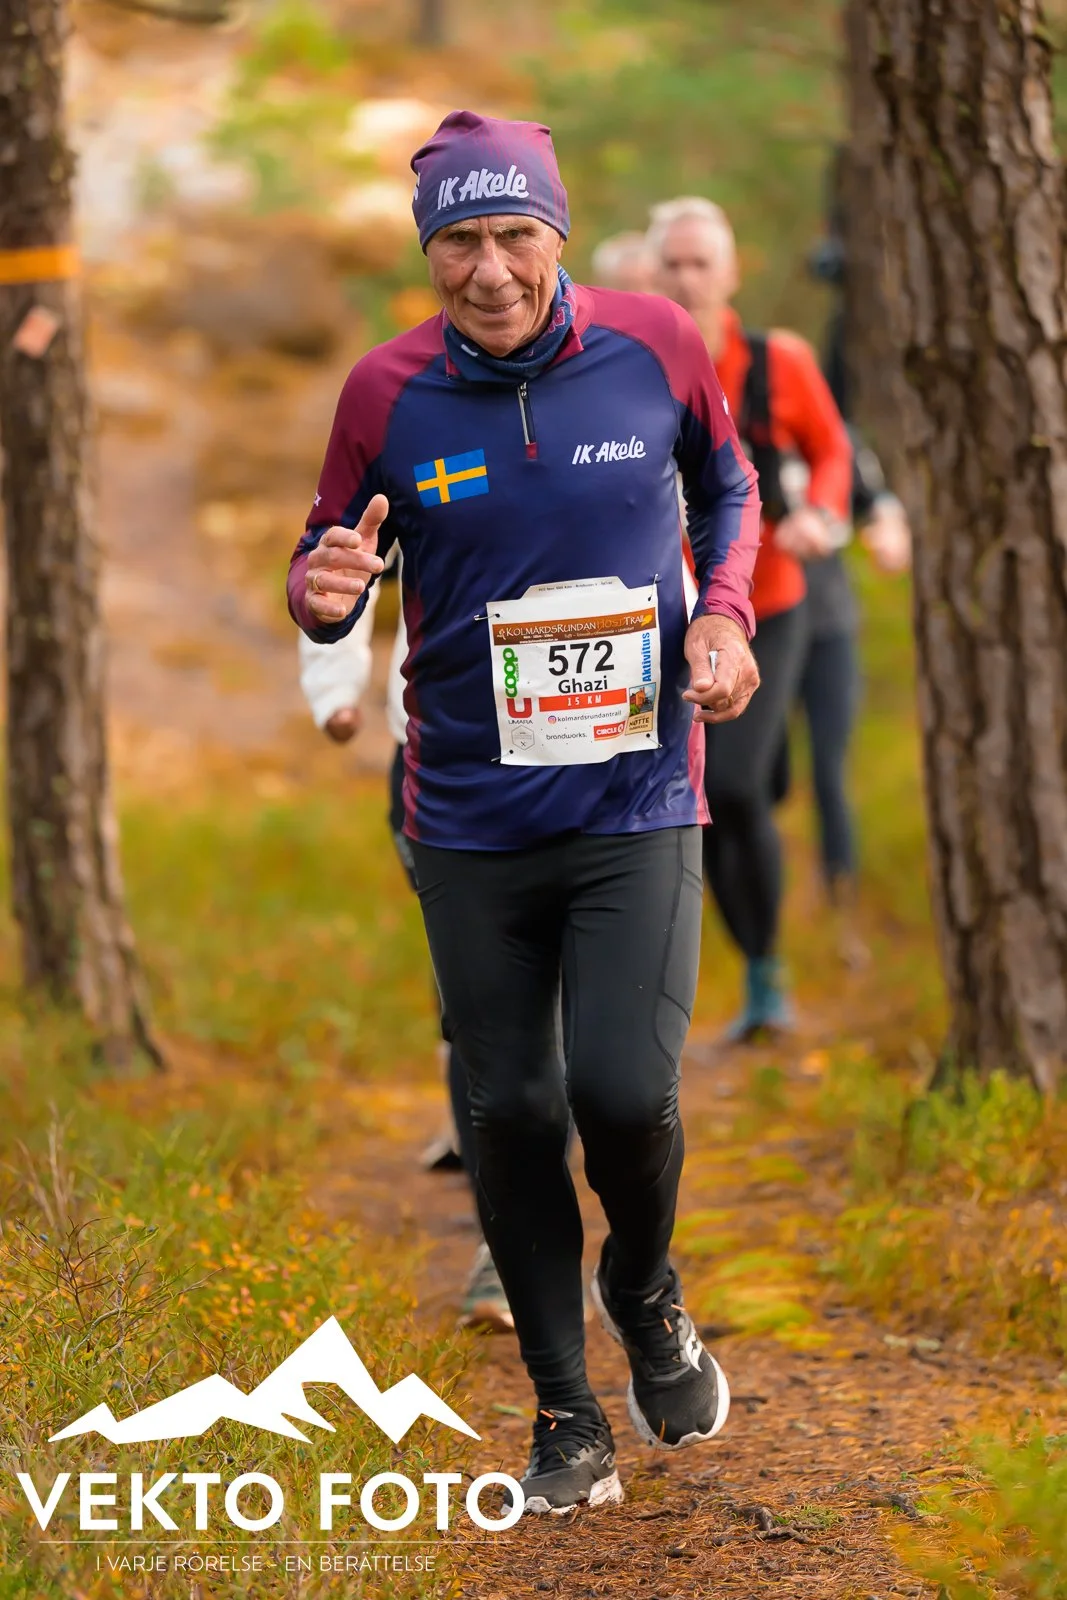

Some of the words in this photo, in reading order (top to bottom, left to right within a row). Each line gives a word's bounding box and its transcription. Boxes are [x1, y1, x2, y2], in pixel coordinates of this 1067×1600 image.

[437, 176, 460, 210] IK
[571, 444, 595, 465] IK
[548, 640, 615, 676] 572
[642, 631, 652, 682] Aktivitus
[503, 647, 518, 697] coop
[558, 675, 608, 694] Ghazi
[567, 697, 580, 706] 15
[587, 694, 602, 704] KM
[557, 710, 622, 722] kolmardsrundantrail
